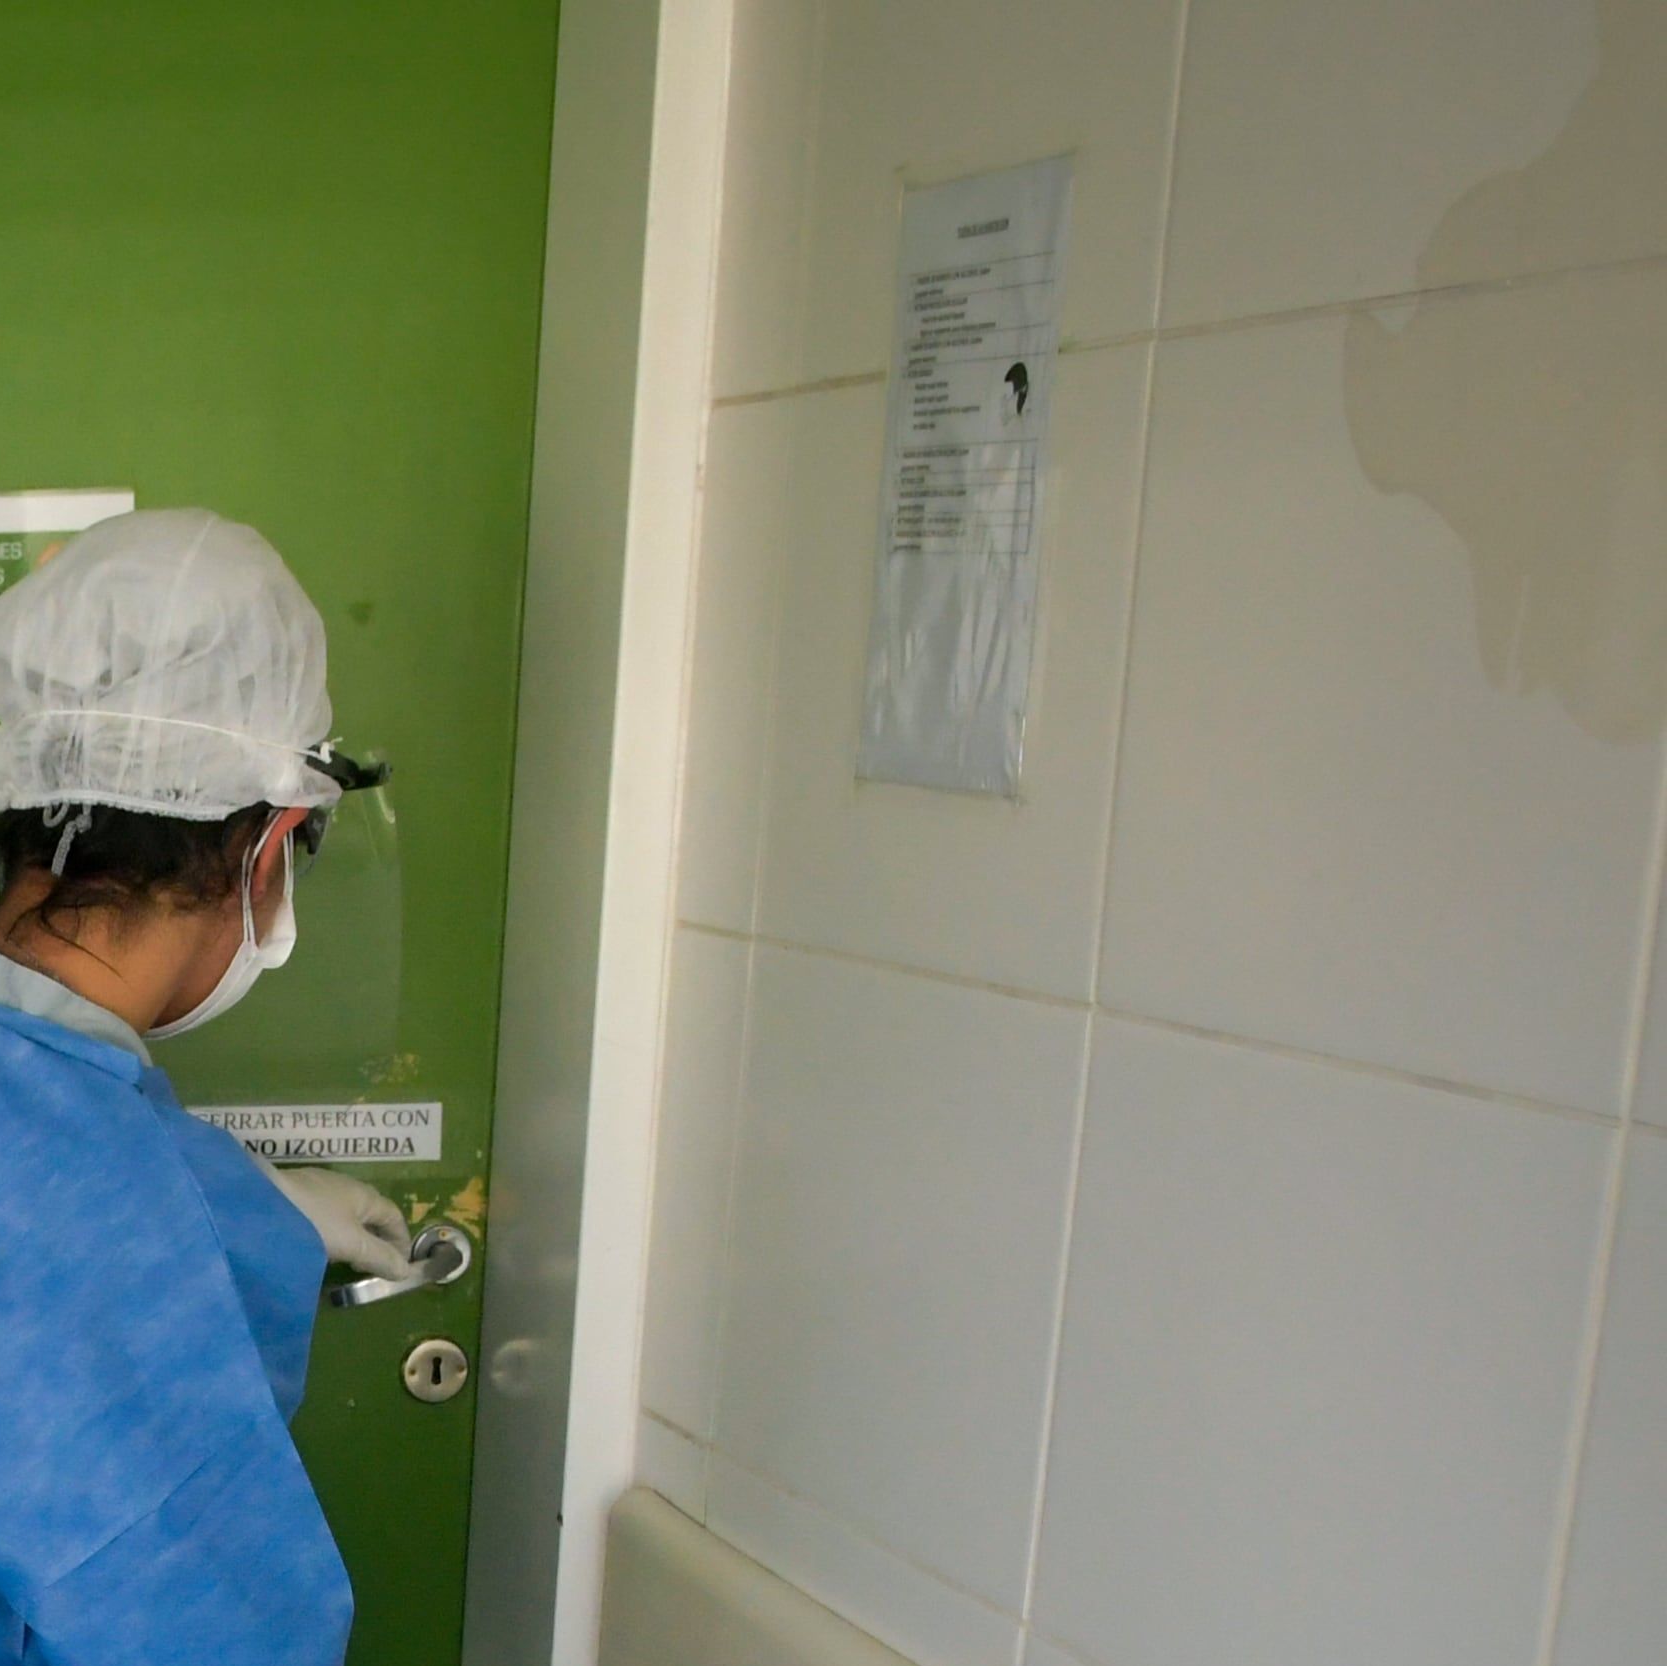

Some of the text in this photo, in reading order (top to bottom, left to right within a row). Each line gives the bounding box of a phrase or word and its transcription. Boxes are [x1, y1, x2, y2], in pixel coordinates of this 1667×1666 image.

[292, 1109, 376, 1129] PUERTA
[381, 1109, 431, 1127] CON
[284, 1136, 416, 1158] IZQUIERDA
